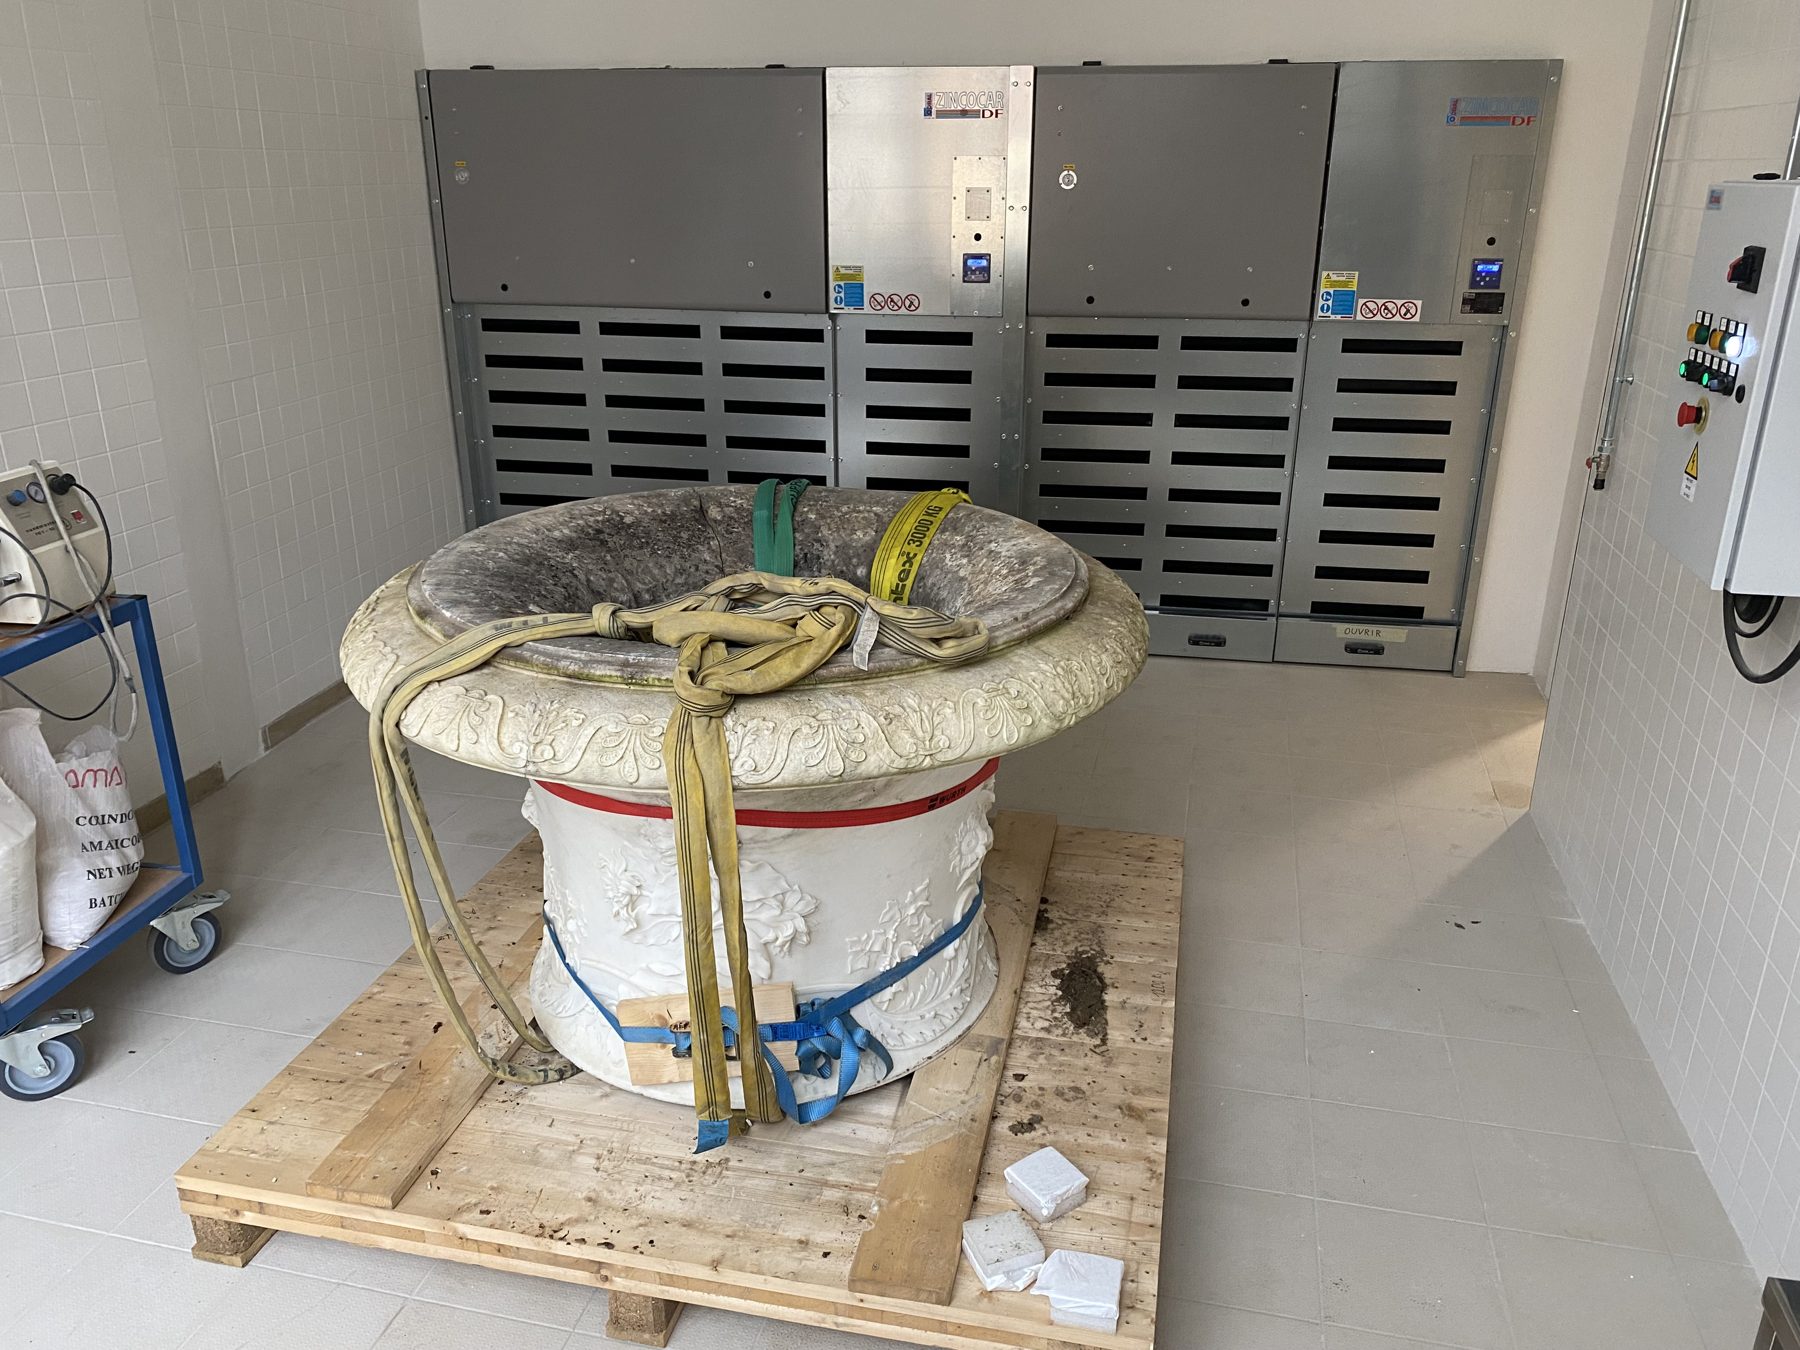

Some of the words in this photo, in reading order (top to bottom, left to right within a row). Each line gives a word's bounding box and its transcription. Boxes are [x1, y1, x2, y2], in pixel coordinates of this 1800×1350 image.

[935, 91, 1004, 108] ZINCOCAR
[981, 109, 1004, 118] DF
[1511, 116, 1537, 126] DF
[907, 519, 934, 548] 3000
[922, 504, 944, 519] KG
[1344, 627, 1382, 638] OUVRIR
[86, 867, 113, 881] NET
